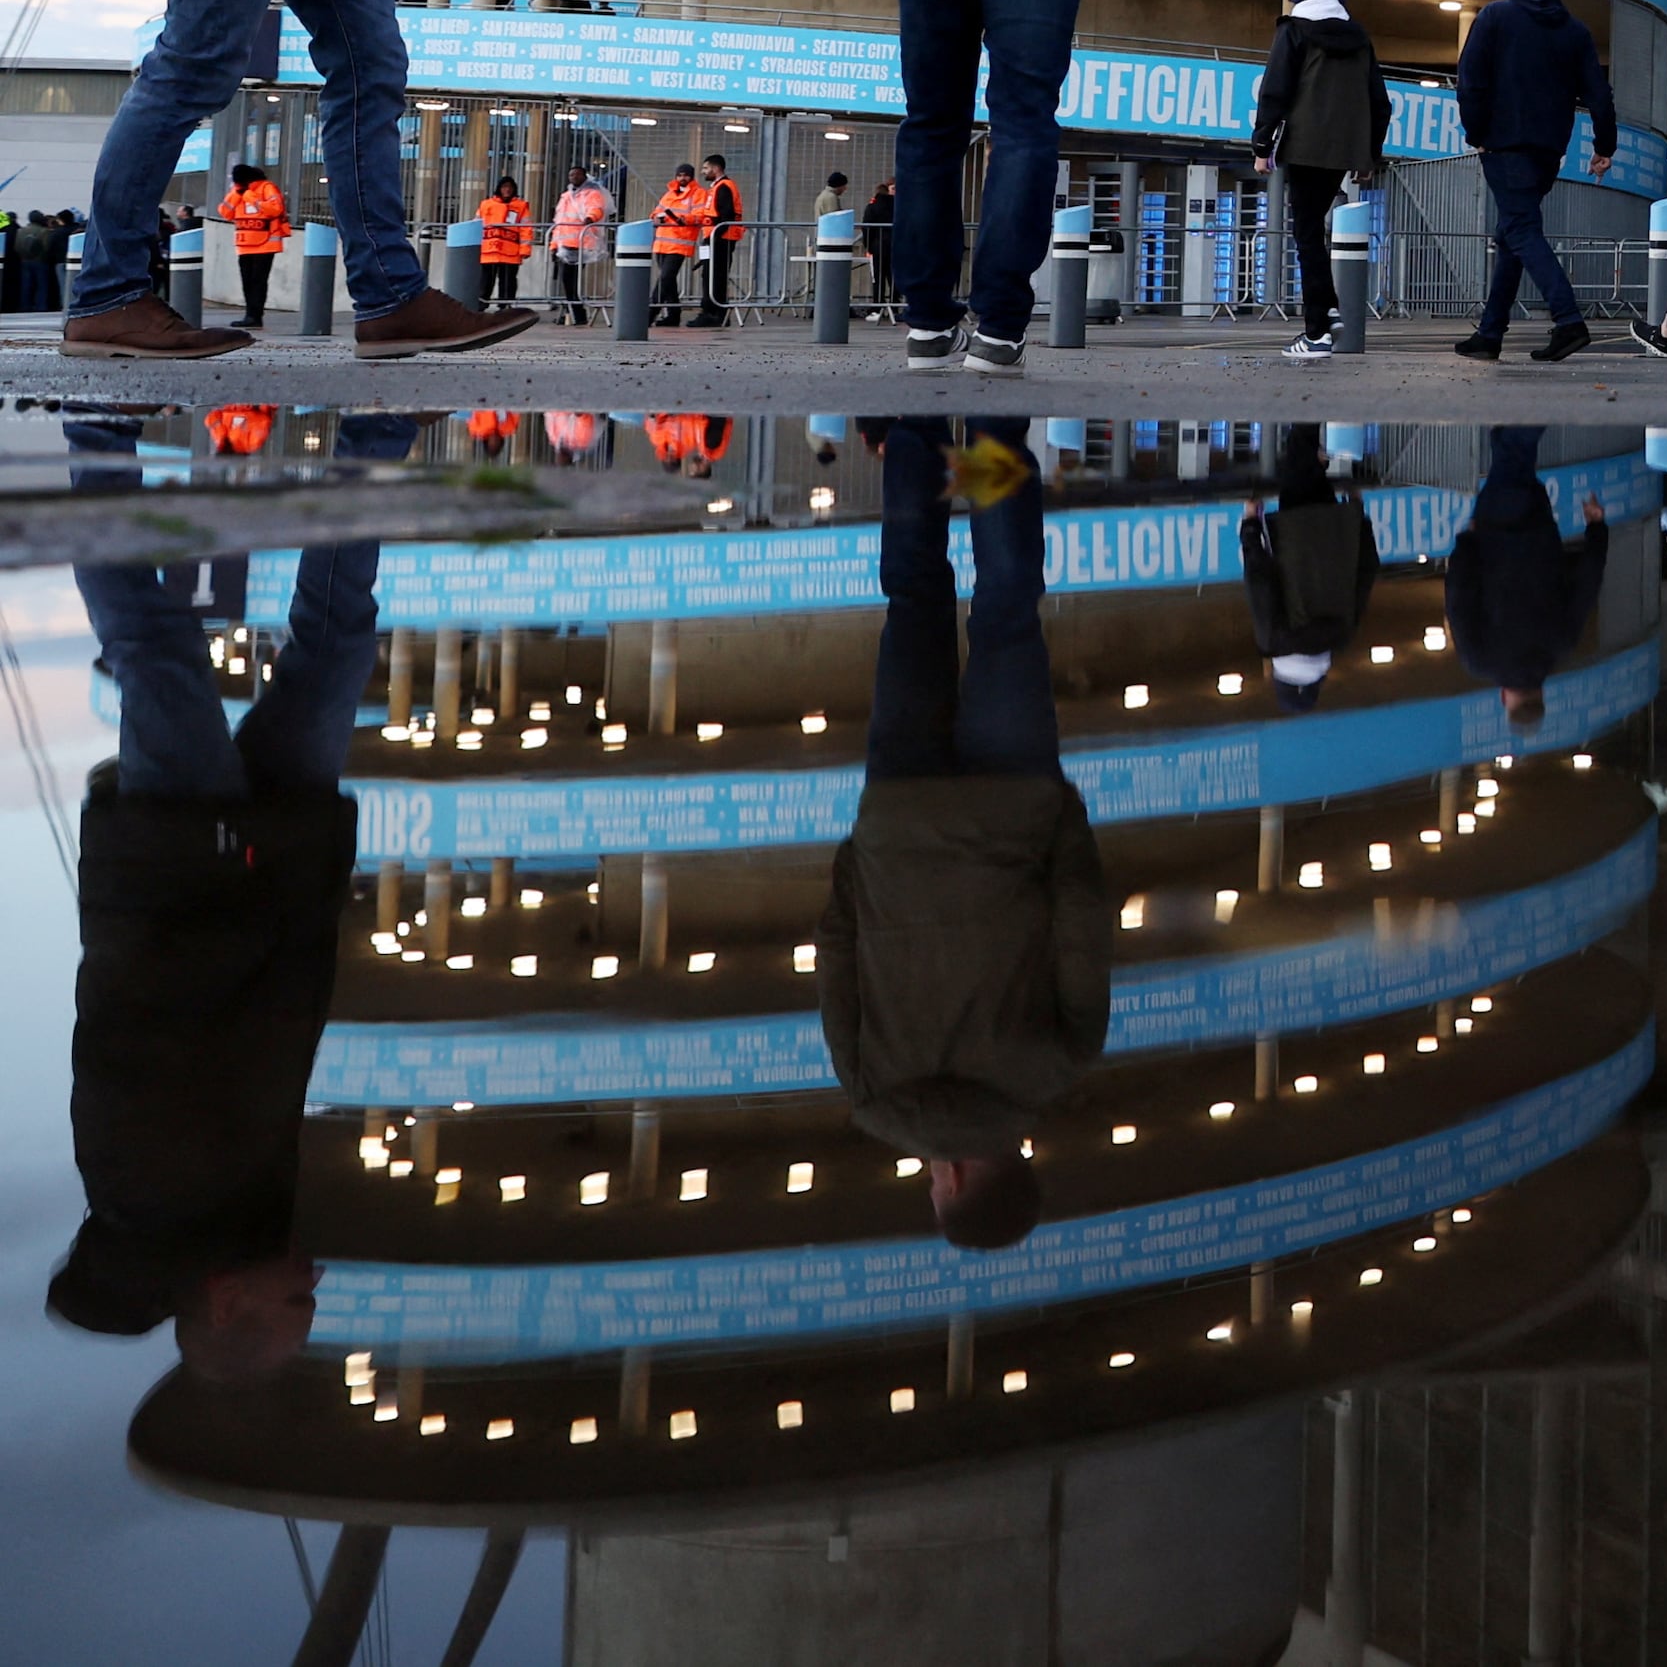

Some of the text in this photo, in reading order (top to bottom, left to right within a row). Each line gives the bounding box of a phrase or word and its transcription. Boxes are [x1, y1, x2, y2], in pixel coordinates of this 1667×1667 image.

[711, 32, 896, 59] SCANDINAVIA SEATTLE CITY
[696, 52, 888, 81] SYDNEY SYRACUSE CITYZENS
[650, 71, 684, 89] WEST
[687, 73, 726, 91] LAKES
[746, 77, 782, 95] WEST
[785, 80, 856, 100] YORKSHIRE
[1056, 59, 1241, 129] OFFICIAL
